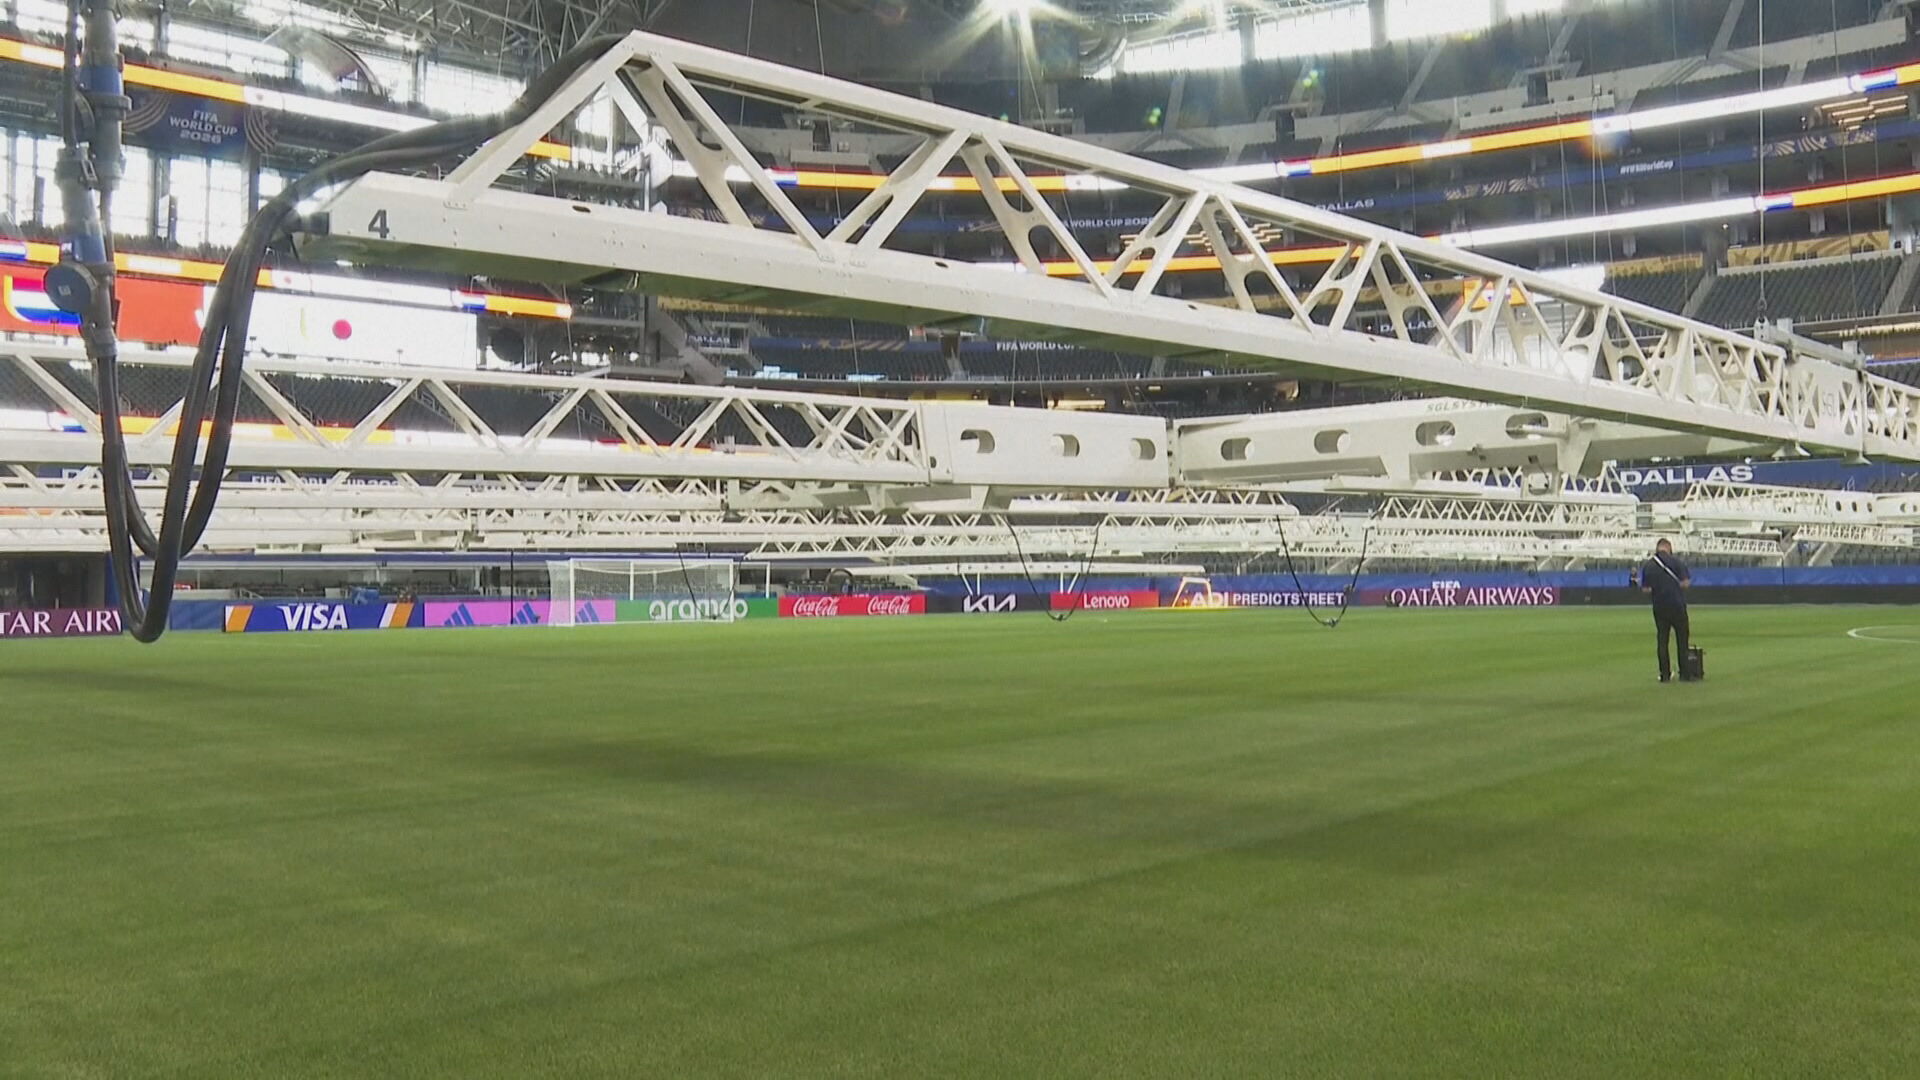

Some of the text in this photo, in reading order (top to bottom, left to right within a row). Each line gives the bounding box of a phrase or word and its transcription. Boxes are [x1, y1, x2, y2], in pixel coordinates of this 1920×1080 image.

[192, 109, 218, 123] FIFA
[169, 116, 238, 136] WORLD CUP
[179, 129, 222, 144] 2026
[368, 209, 390, 239] 4
[1071, 219, 1103, 229] WORLD
[1104, 218, 1124, 227] CUP
[996, 341, 1018, 351] FIFA
[1019, 341, 1056, 350] WORLD
[1620, 465, 1754, 486] DALLAS
[1432, 580, 1461, 589] FIFA
[1083, 594, 1130, 609] Lenovo
[1190, 592, 1345, 607] ADI PREDICTSTREET
[1391, 587, 1554, 607] QATAR AIRWAYS
[276, 604, 349, 630] VISA
